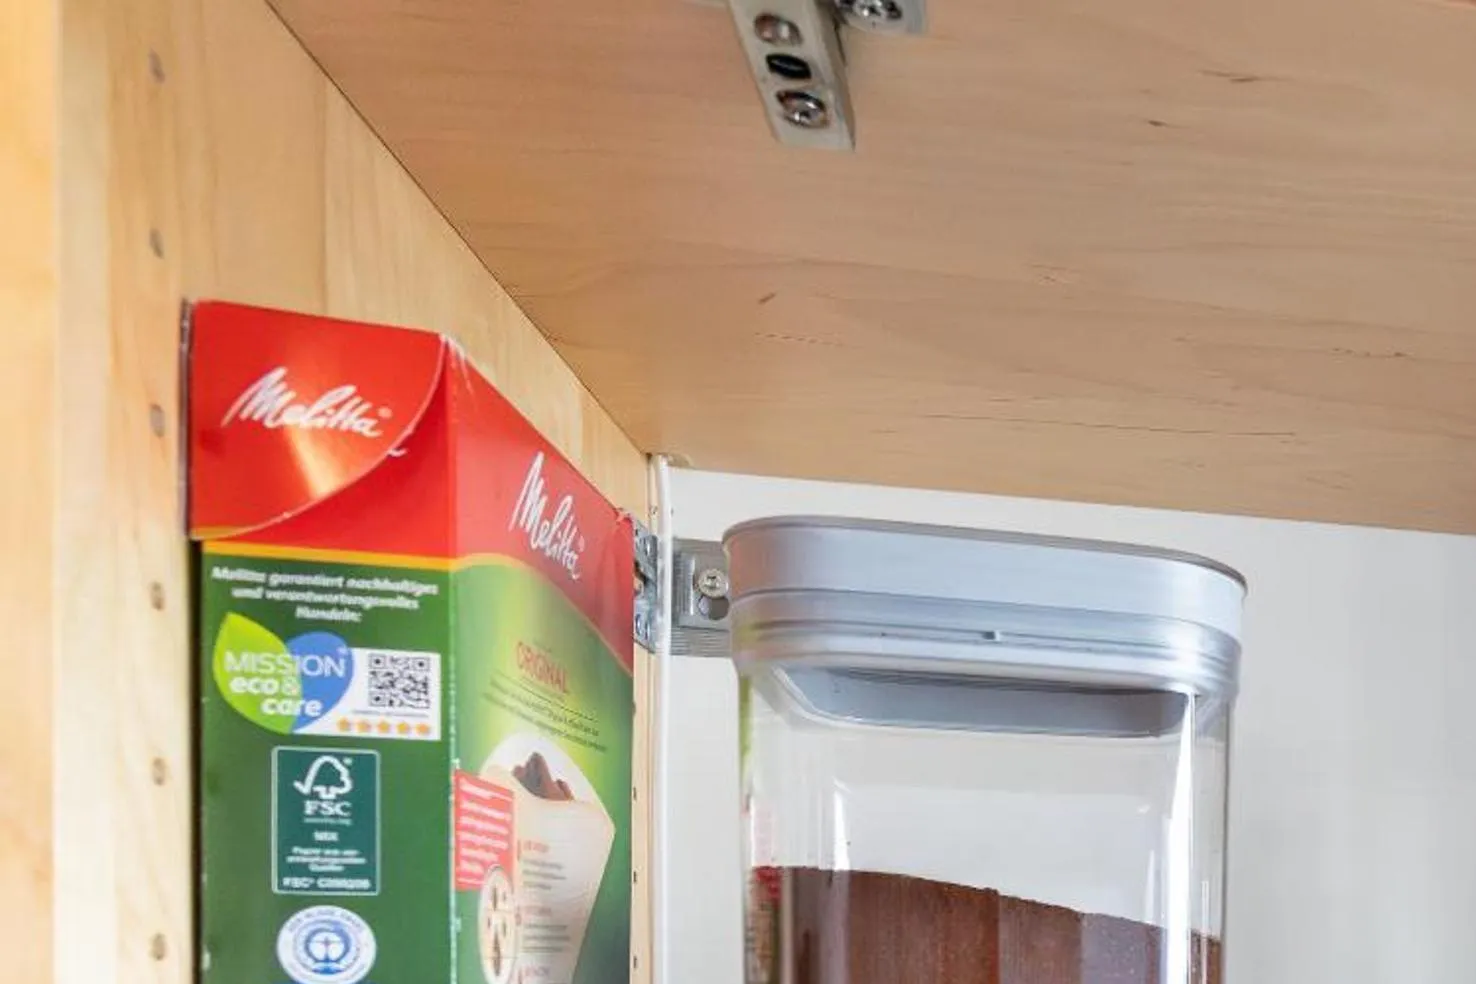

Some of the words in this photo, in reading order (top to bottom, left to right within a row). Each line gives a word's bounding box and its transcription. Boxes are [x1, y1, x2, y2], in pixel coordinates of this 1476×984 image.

[221, 366, 382, 437] Melitta
[509, 450, 580, 580] Melitta
[224, 652, 346, 677] MISSION
[261, 698, 323, 717] care
[304, 800, 352, 817] FSC
